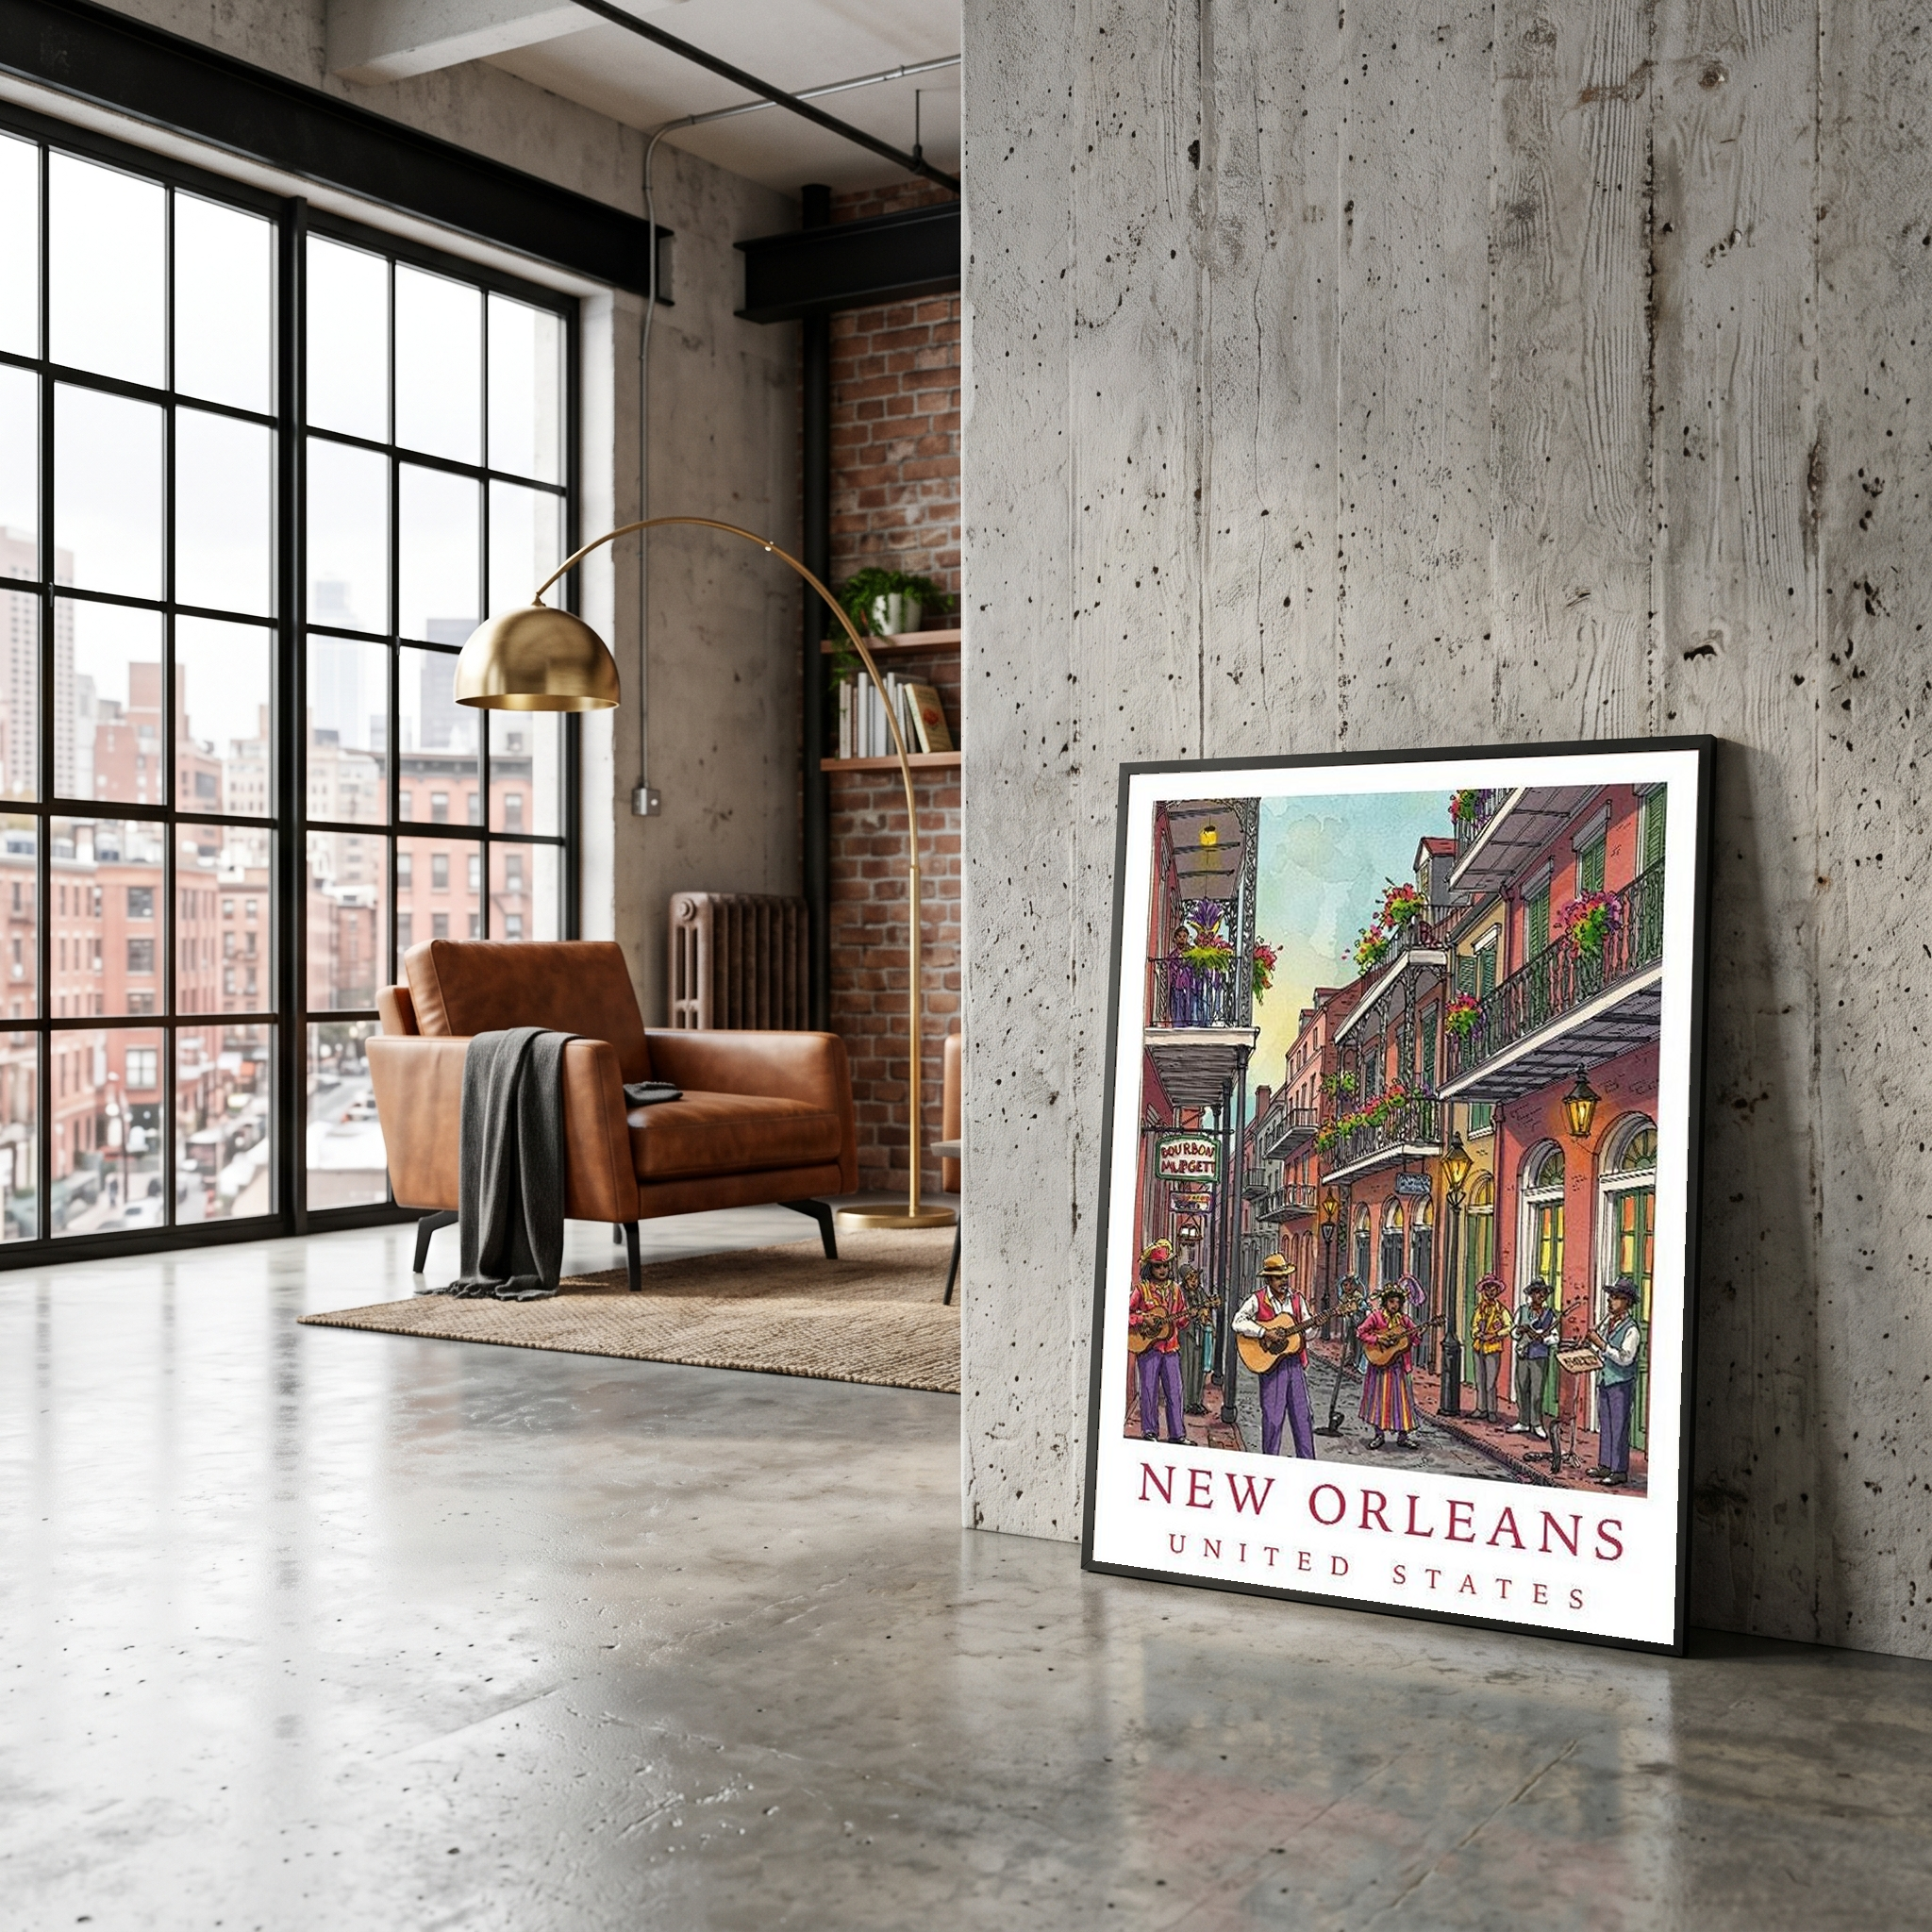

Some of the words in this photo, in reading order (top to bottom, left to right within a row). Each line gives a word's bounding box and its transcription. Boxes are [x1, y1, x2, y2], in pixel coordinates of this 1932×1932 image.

[1161, 1142, 1215, 1158] BOURBON
[1139, 1461, 1274, 1517] NEW
[1308, 1484, 1624, 1561] ORLEANS
[1170, 1534, 1349, 1575] UNITED
[1392, 1565, 1584, 1610] STATES
